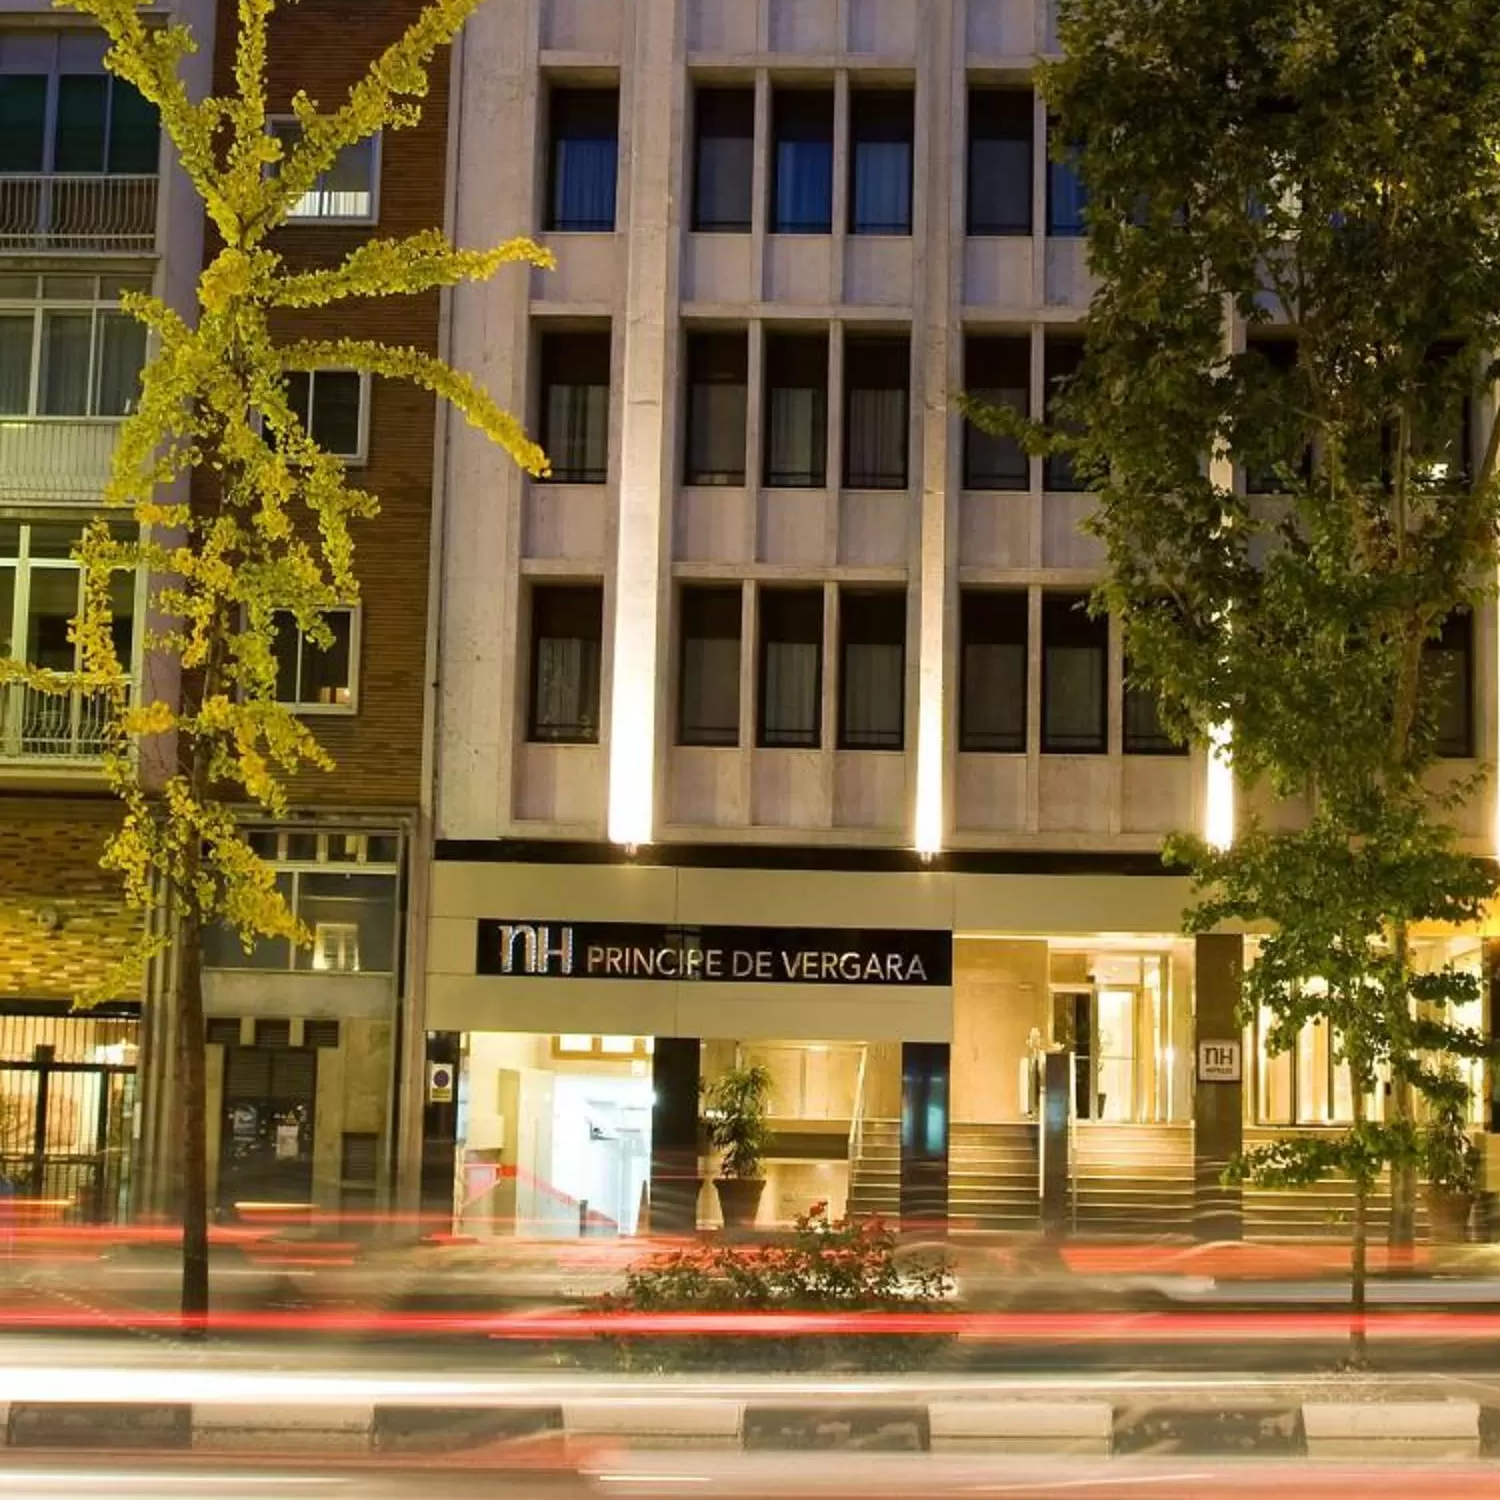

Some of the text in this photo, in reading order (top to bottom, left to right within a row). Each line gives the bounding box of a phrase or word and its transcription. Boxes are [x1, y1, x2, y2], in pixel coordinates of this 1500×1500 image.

[587, 945, 723, 977] PRINCIPE
[732, 951, 773, 977] DE
[781, 951, 928, 981] VERGARA
